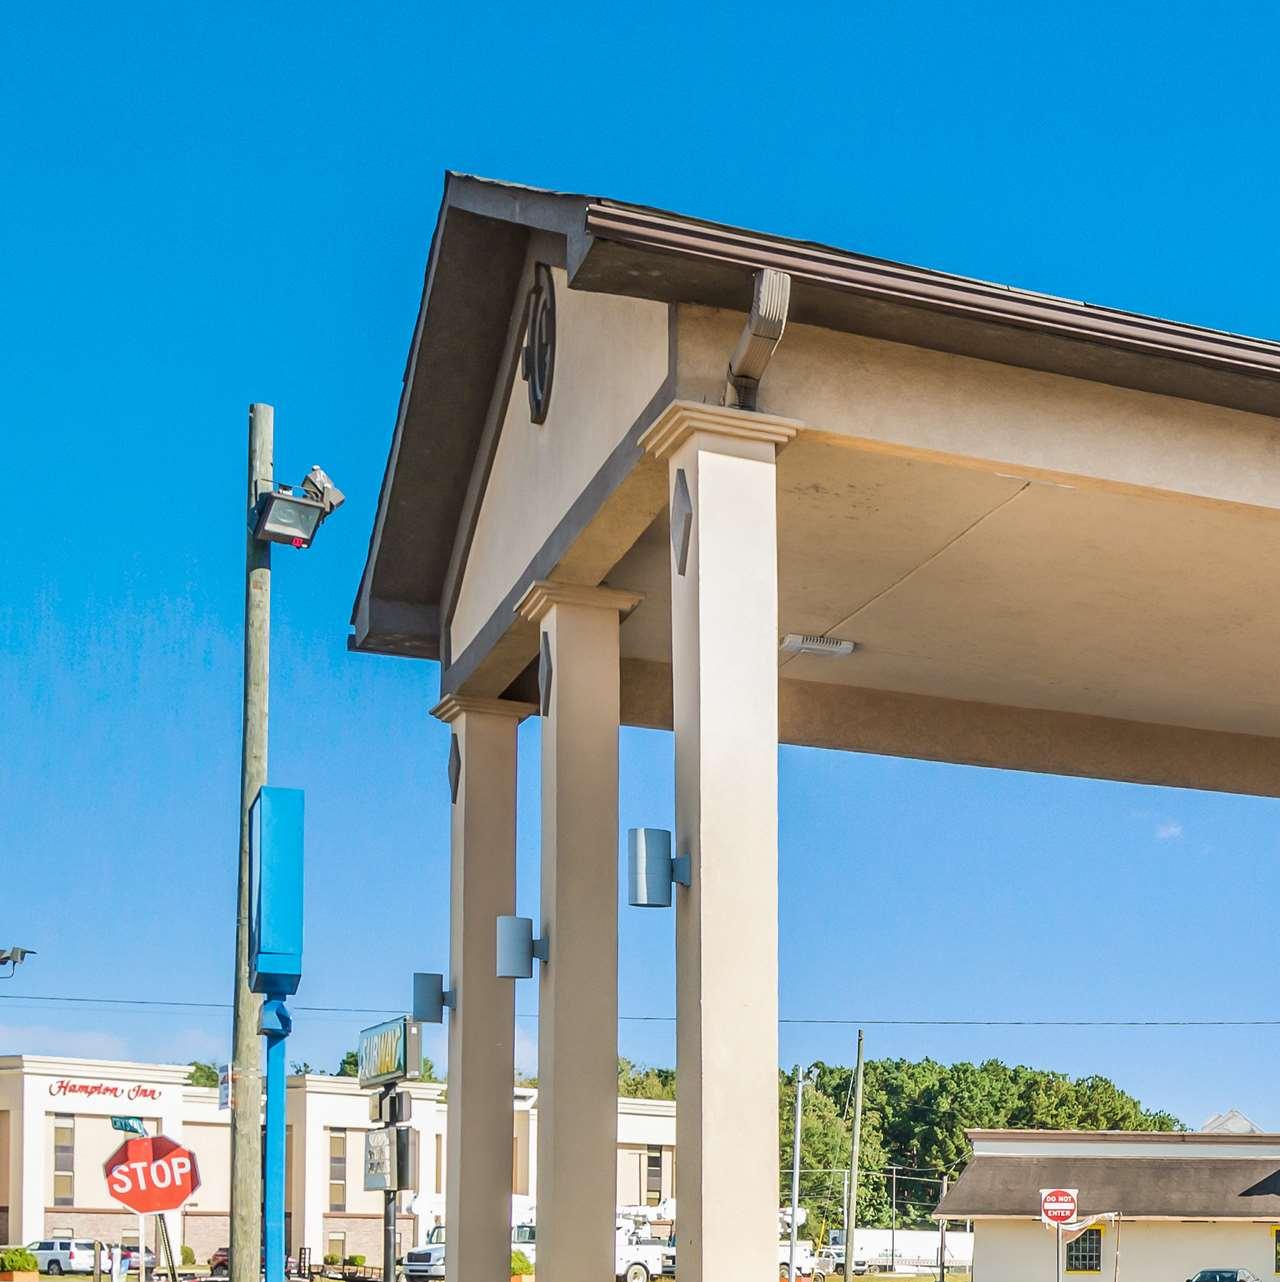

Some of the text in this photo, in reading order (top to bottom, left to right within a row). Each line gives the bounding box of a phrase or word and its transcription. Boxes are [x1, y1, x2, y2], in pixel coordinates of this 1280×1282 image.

[358, 1025, 400, 1079] SUBWAY
[49, 1080, 162, 1101] Hampton Inn
[112, 1157, 191, 1193] STOP
